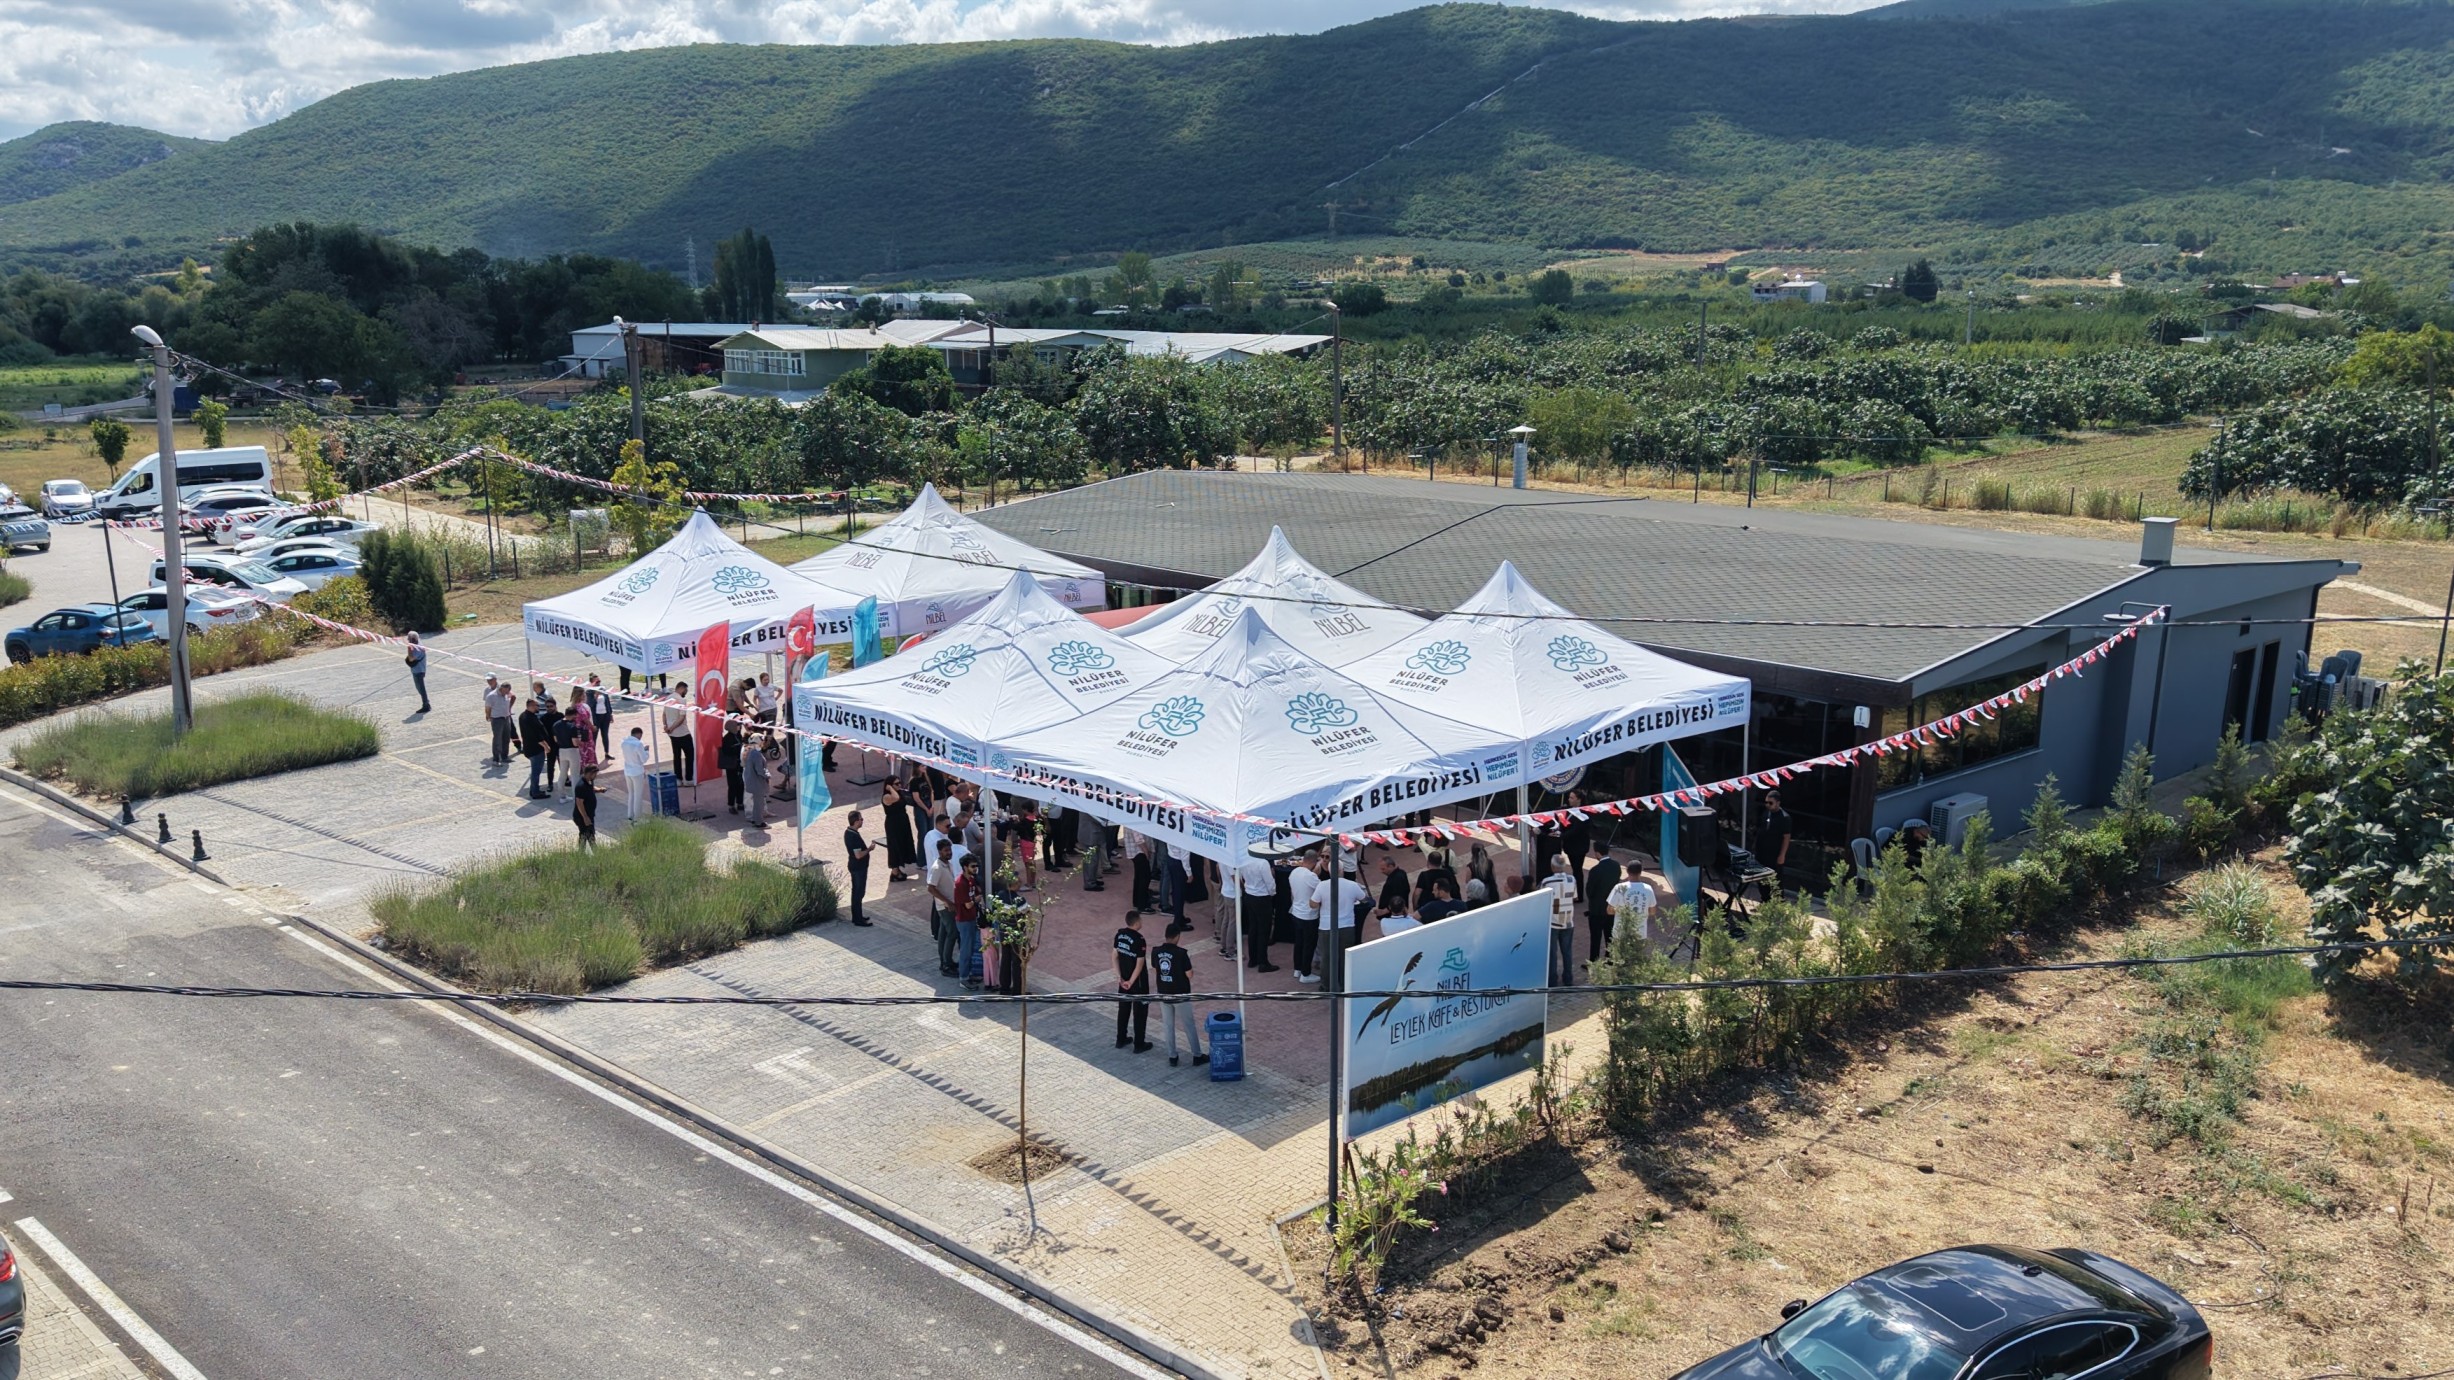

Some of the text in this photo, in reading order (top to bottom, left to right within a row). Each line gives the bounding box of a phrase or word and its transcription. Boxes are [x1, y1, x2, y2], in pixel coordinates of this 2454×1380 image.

[727, 588, 776, 602] NİLÜFER
[731, 594, 779, 607] BELEDİYESİ
[1313, 612, 1371, 639] NİLBEL
[535, 616, 571, 639] NİLÜFER
[573, 626, 624, 656] BELEDİYESİ
[909, 673, 951, 689] NİLÜFER
[1068, 669, 1124, 686] NİLÜFER
[1396, 669, 1449, 686] NİLÜFER
[1572, 664, 1621, 683] NİLÜFER
[1582, 672, 1629, 690] BELEDİYESİ
[900, 681, 944, 695] BELEDİYESİ
[1075, 677, 1129, 693] BELEDİYESİ
[1389, 678, 1442, 693] BELEDİYESİ
[814, 702, 946, 759] NİLÜFER BELEDİYESİ
[1311, 726, 1371, 747] NİLÜFER
[1554, 698, 1714, 761] NİLÜFER BELEDİYESİ
[1117, 740, 1170, 757] BELEDİYESİ
[1126, 731, 1179, 750] NİLÜFER
[1320, 735, 1378, 755] BELEDİYESİ
[1485, 758, 1518, 772] HEPİMİZİN
[1370, 761, 1481, 809] BELEDİYESİ
[1084, 781, 1184, 833] BELEDİYESİ
[1191, 821, 1227, 838] HEPİMİZİN
[1191, 829, 1227, 848] NİLÜFER'İ
[1390, 1013, 1425, 1045] LEYLEK
[1428, 1004, 1452, 1031] KAFE
[1453, 1006, 1460, 1018] &
